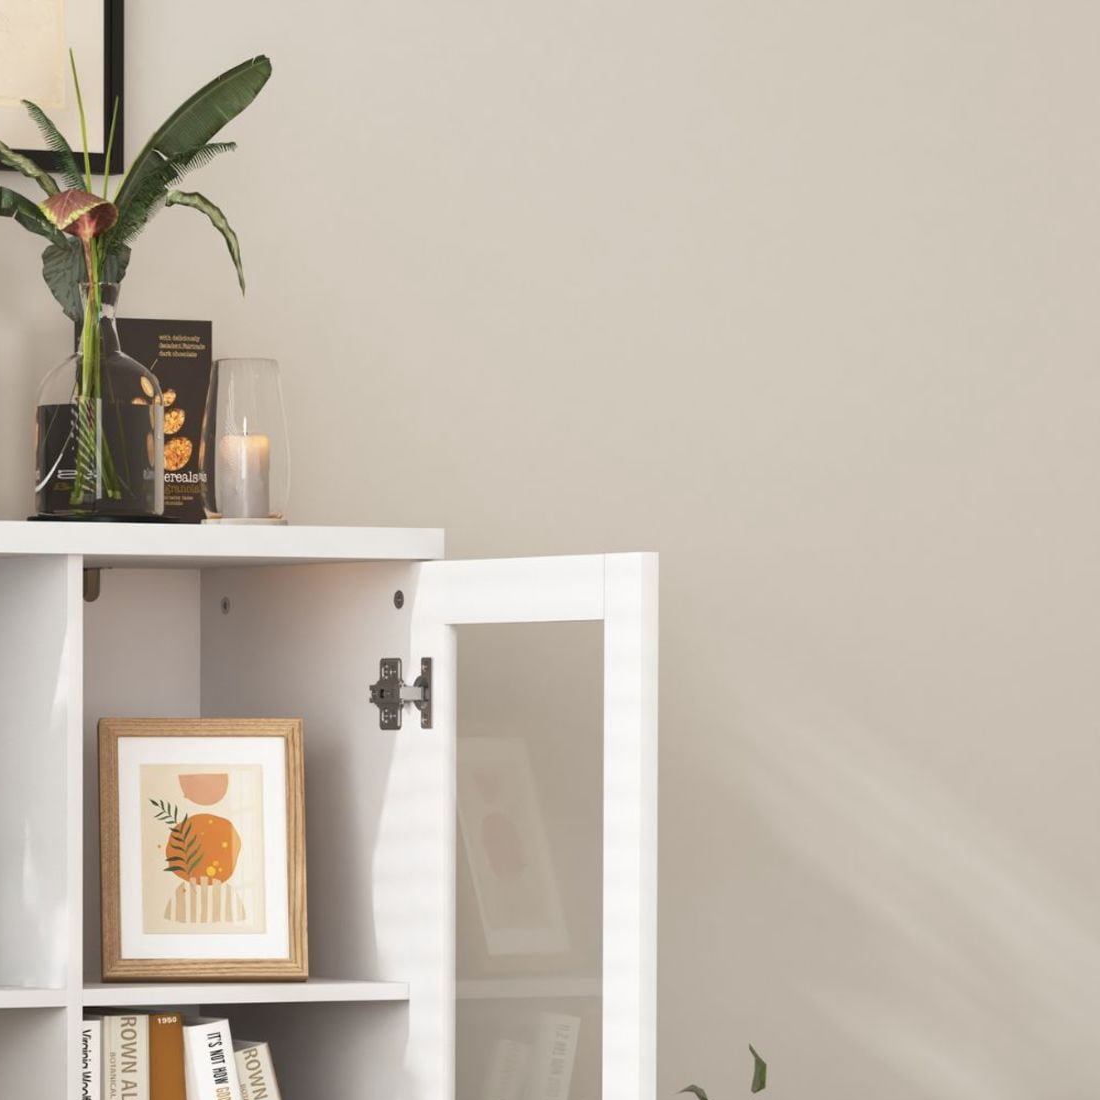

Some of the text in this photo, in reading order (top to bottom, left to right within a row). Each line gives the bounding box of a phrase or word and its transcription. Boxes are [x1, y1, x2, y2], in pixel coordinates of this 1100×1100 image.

[206, 1031, 222, 1048] IT'S
[210, 1050, 226, 1065] NOT
[212, 1066, 229, 1085] HOW
